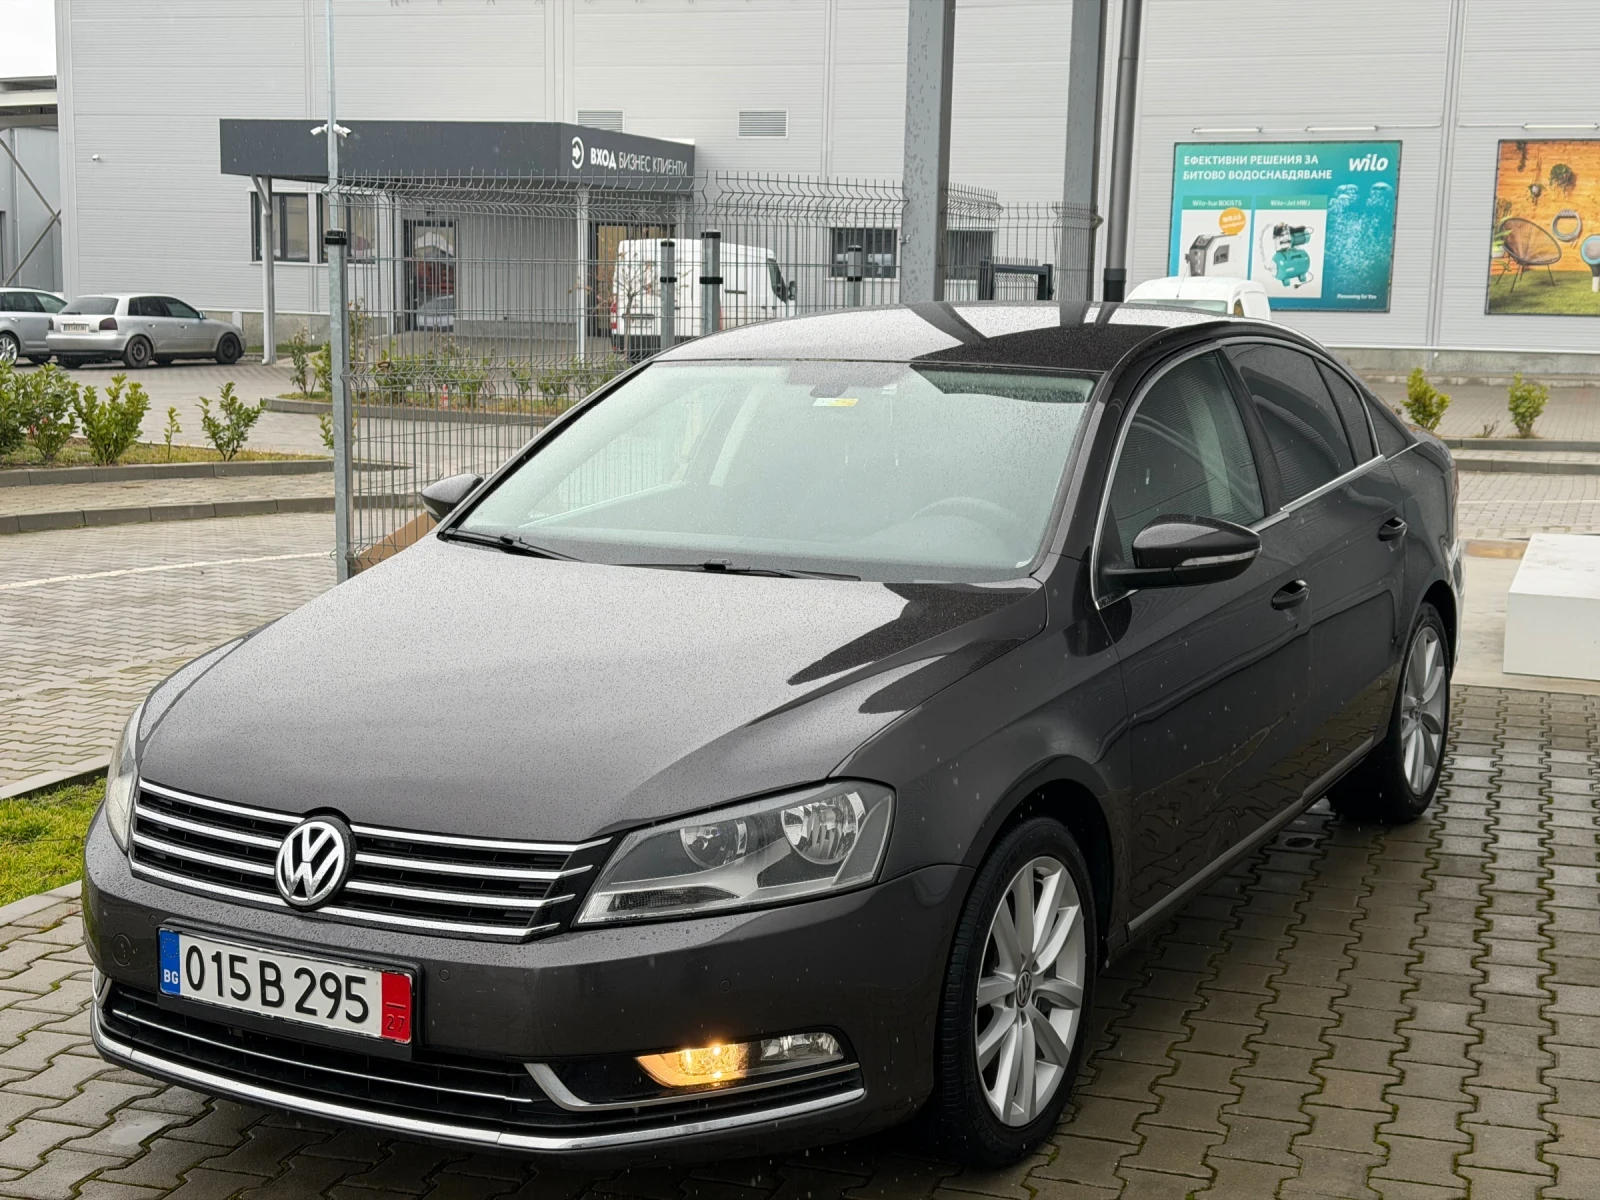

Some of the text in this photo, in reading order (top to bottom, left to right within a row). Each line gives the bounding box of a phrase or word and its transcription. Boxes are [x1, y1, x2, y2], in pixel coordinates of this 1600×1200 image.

[590, 147, 688, 177] ВХОД БИЗНЕС КЛИЕНТИ
[1183, 154, 1319, 165] ЕФЕКТИВНИ РЕШЕНИЯ ЗА
[1349, 153, 1389, 172] wilo
[1182, 169, 1333, 181] БИТОВО ВОДОСНАБДЯВАНЕ
[163, 968, 179, 985] BG
[386, 1014, 405, 1033] 27
